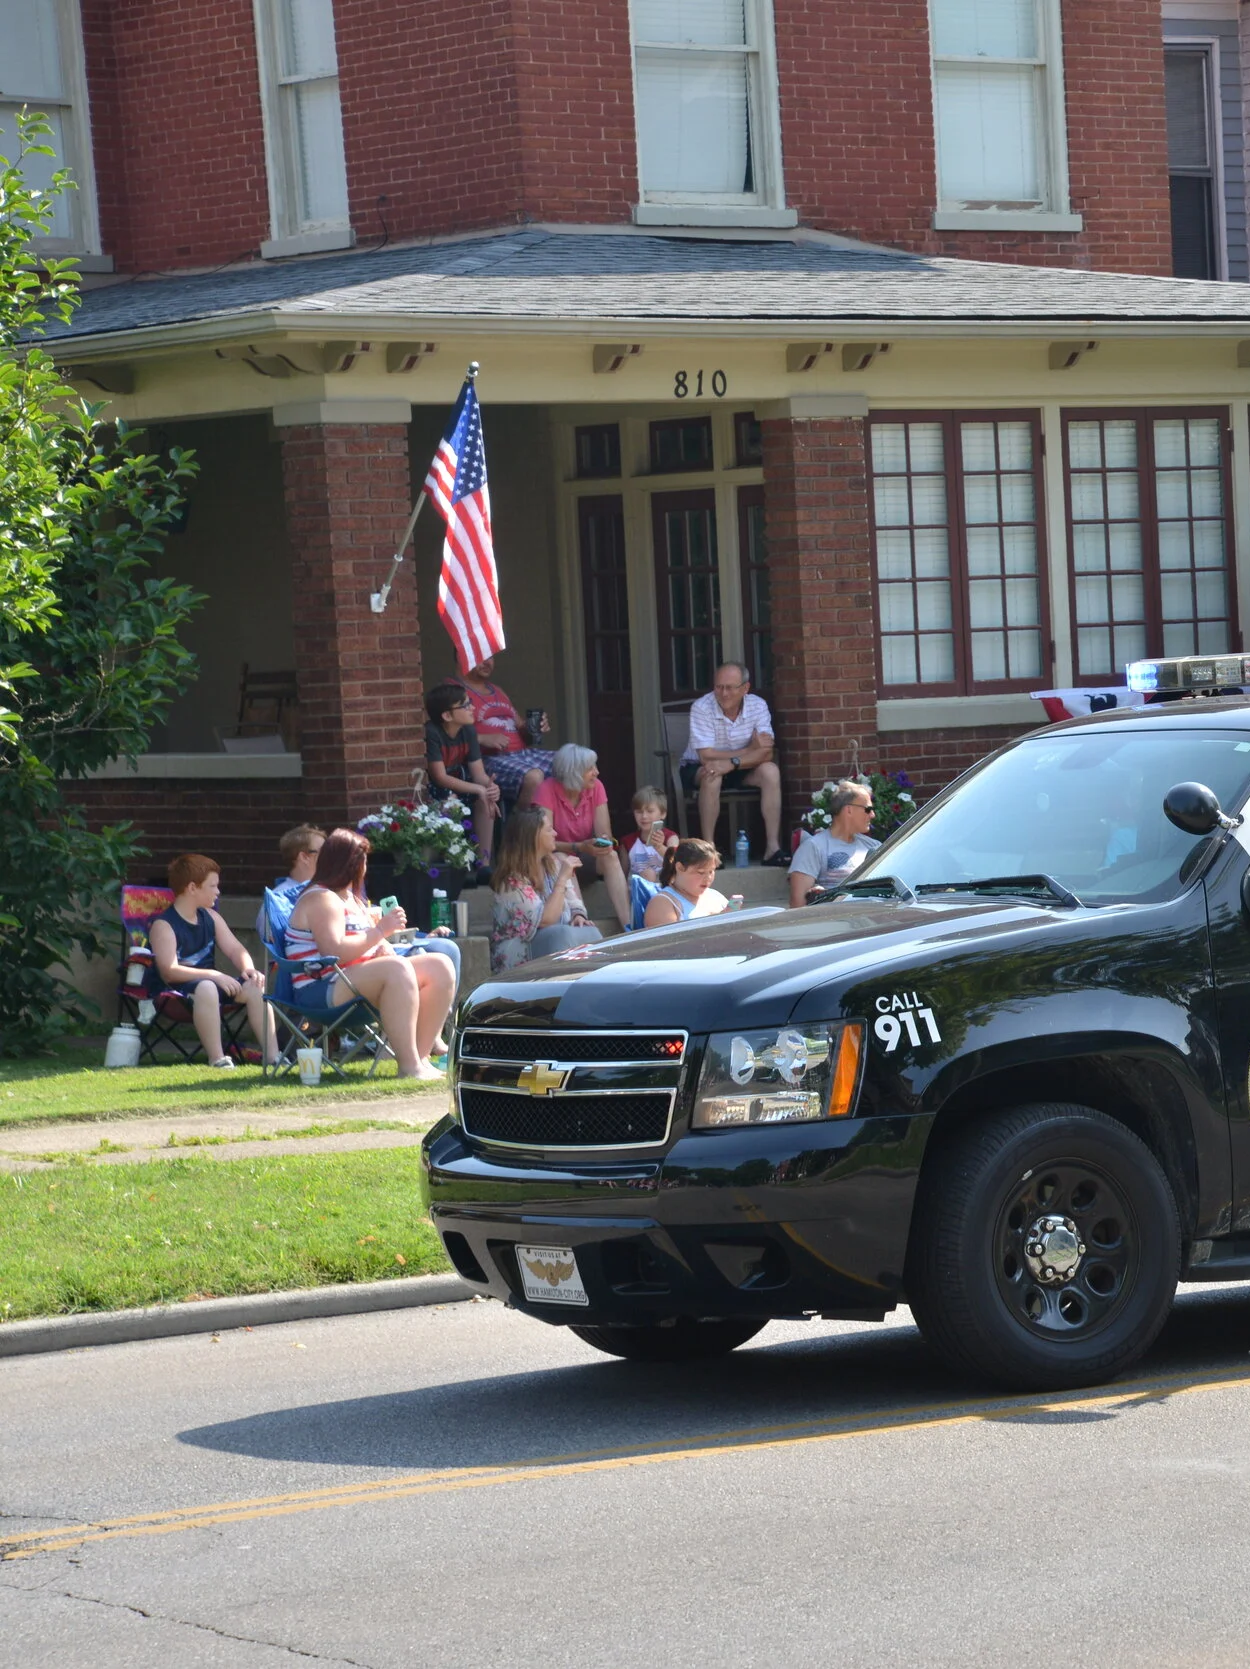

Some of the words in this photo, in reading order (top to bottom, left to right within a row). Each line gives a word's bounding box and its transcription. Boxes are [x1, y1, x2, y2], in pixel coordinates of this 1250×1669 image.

[674, 369, 727, 398] 810
[875, 991, 923, 1013] CALL
[874, 1007, 942, 1052] 911
